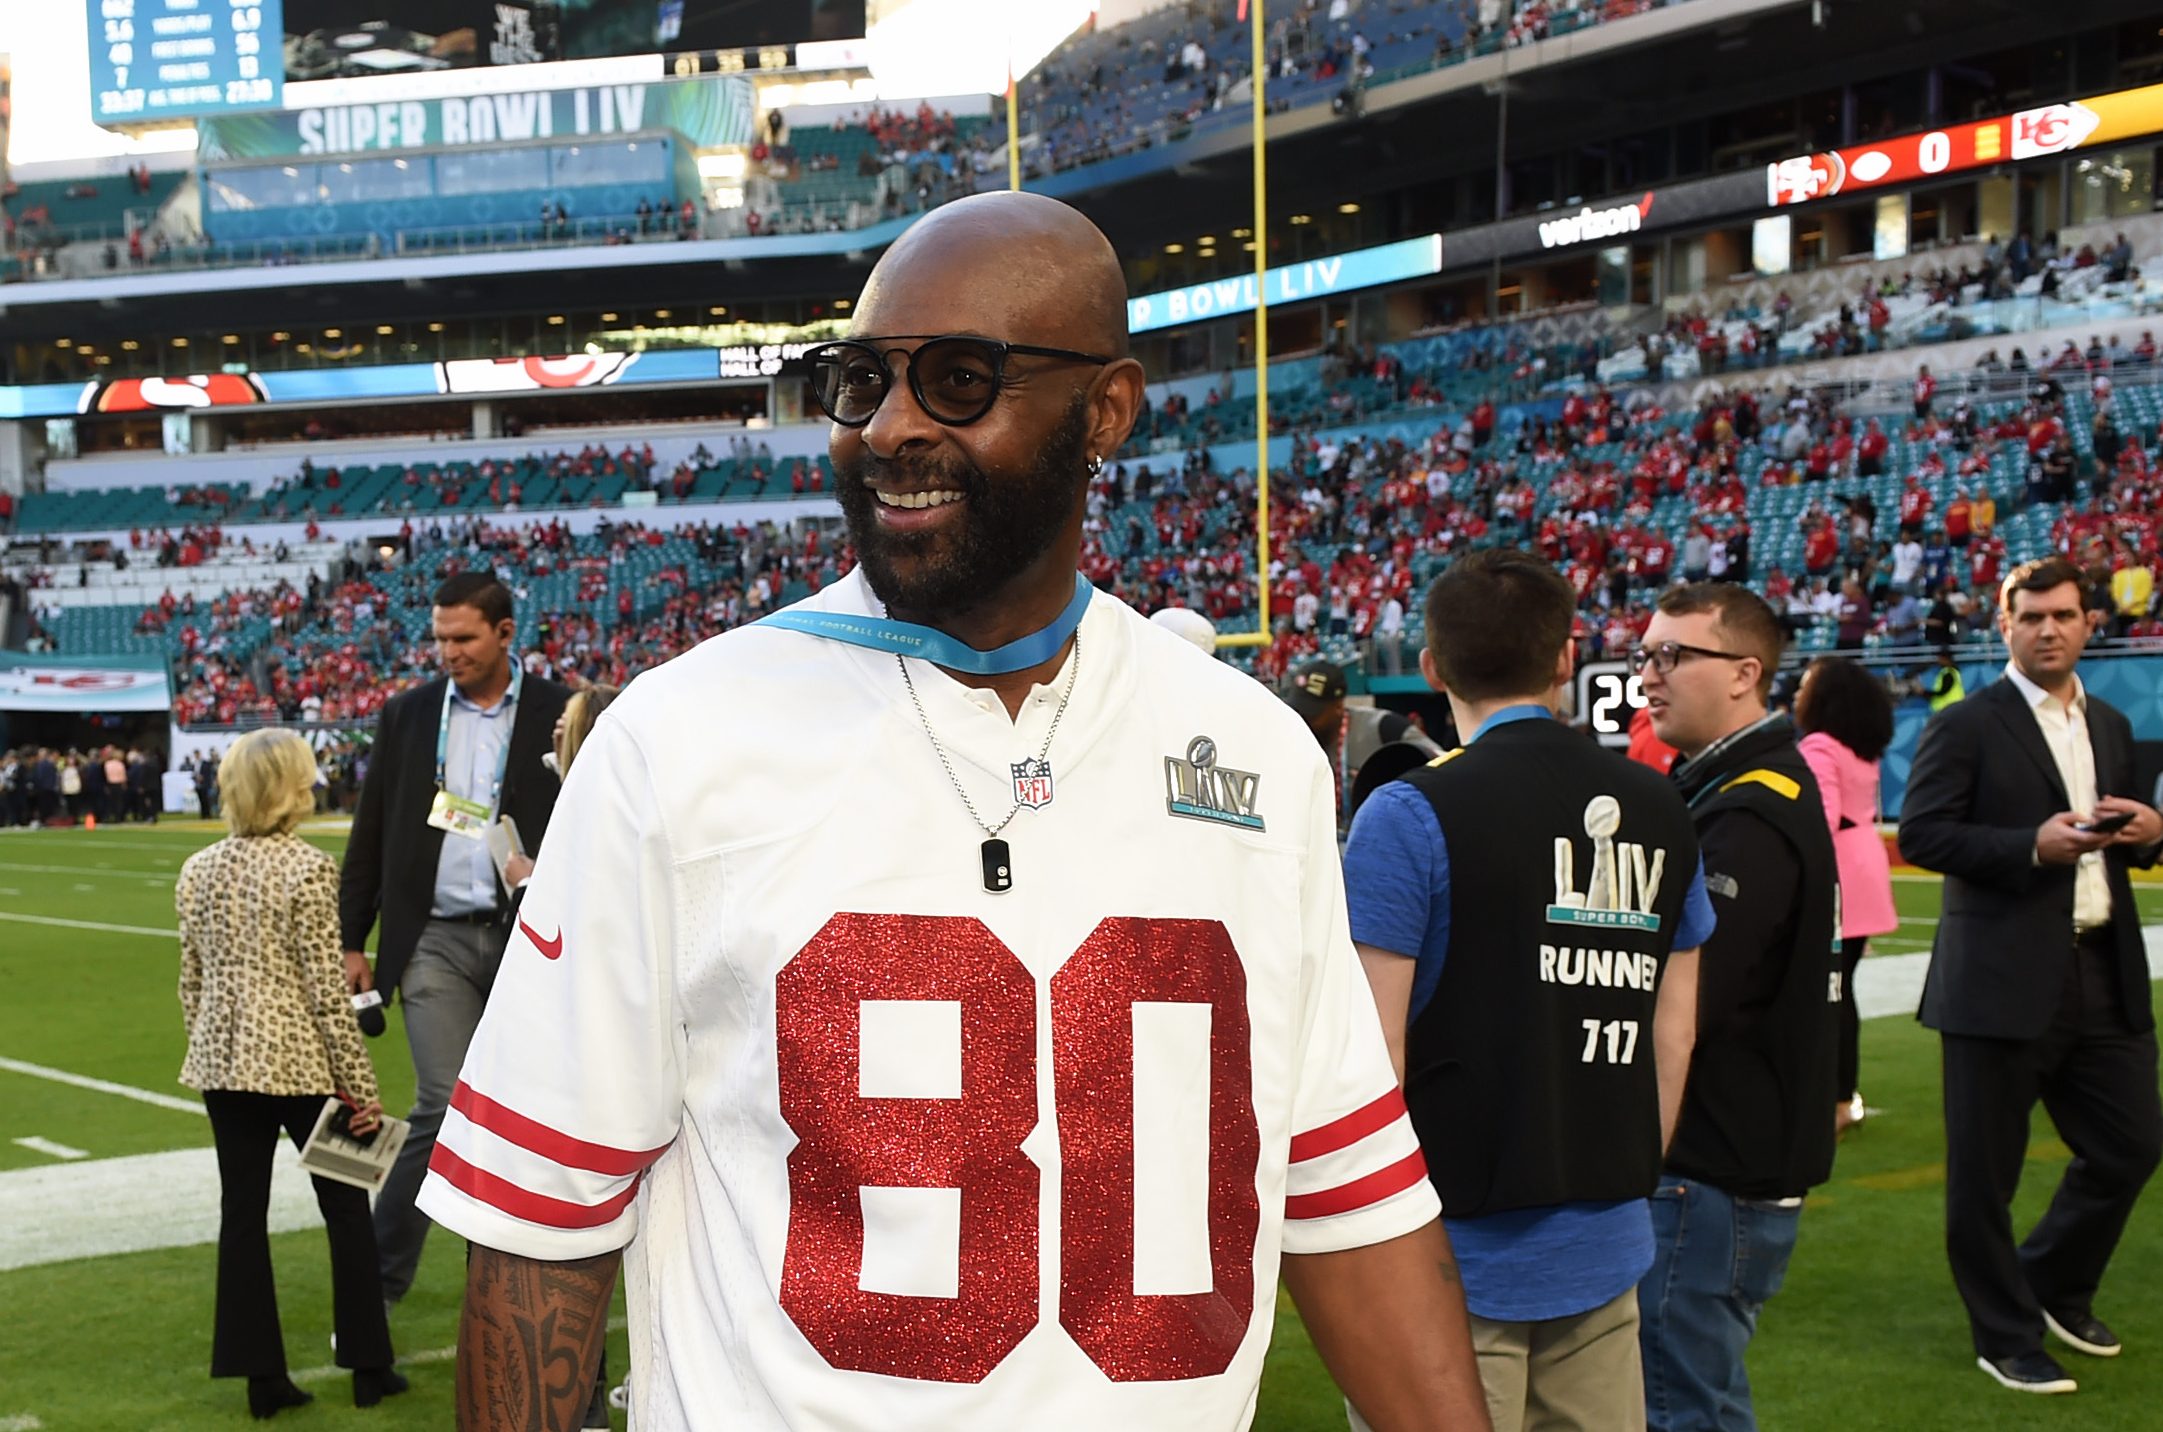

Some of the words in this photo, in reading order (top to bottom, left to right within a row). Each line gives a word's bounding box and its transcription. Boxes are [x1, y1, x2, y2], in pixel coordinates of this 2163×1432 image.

[298, 101, 427, 154] SUPER
[441, 91, 553, 145] BOWL
[574, 83, 647, 135] LIV
[1917, 131, 1951, 174] 0
[1538, 204, 1641, 249] verizon
[1168, 275, 1261, 321] BOWL
[1280, 256, 1343, 299] LIV
[877, 630, 924, 647] LEAGUE
[1017, 778, 1052, 804] NFL
[1554, 837, 1666, 914] LIV
[1582, 1018, 1639, 1064] 717
[776, 911, 1262, 1384] 80
